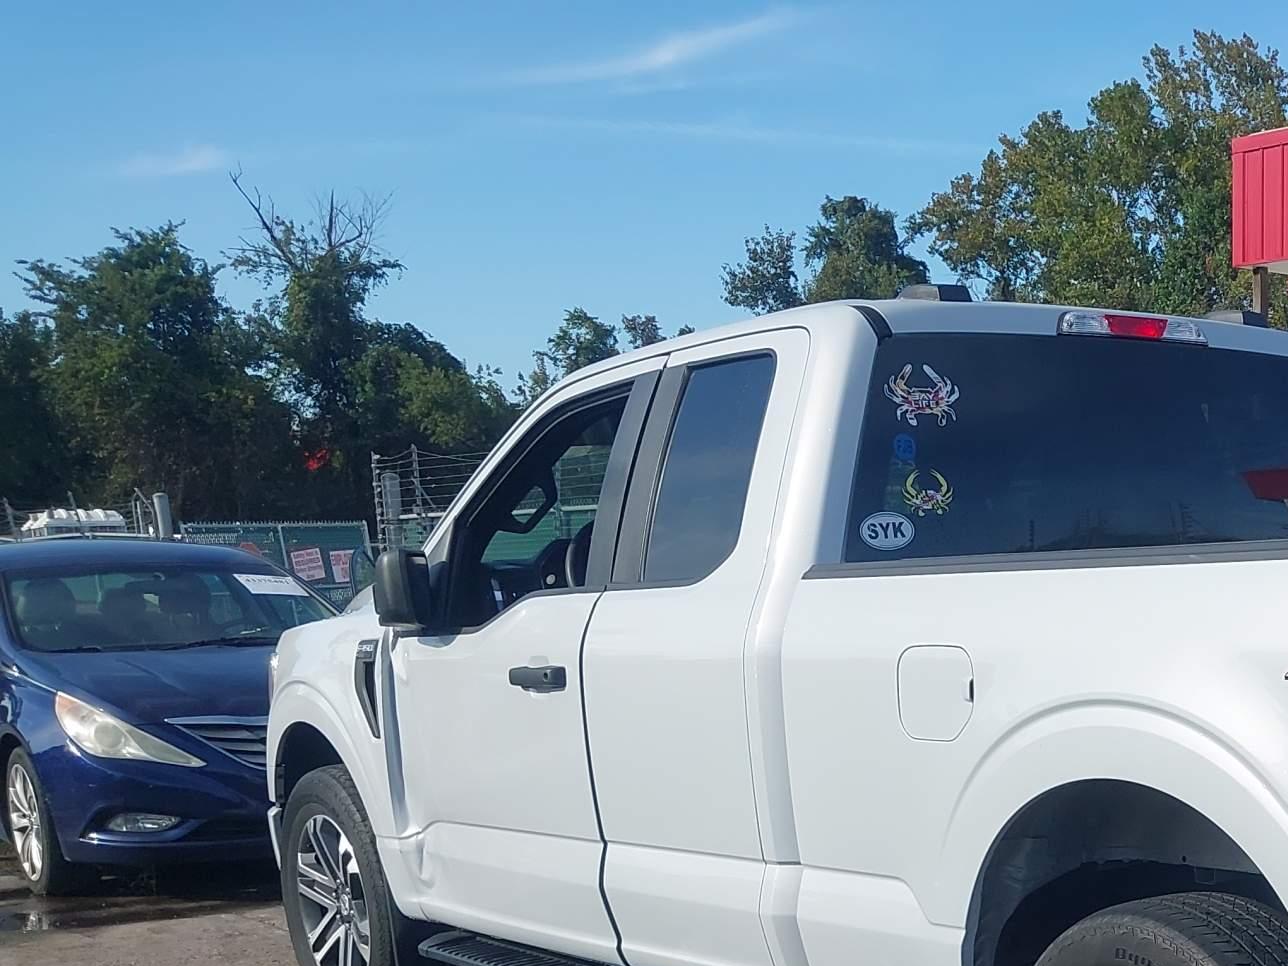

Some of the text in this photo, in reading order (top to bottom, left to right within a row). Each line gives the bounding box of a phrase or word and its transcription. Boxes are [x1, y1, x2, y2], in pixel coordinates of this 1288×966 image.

[911, 392, 934, 401] BAY
[912, 400, 937, 408] LIFE
[866, 521, 907, 540] SYK
